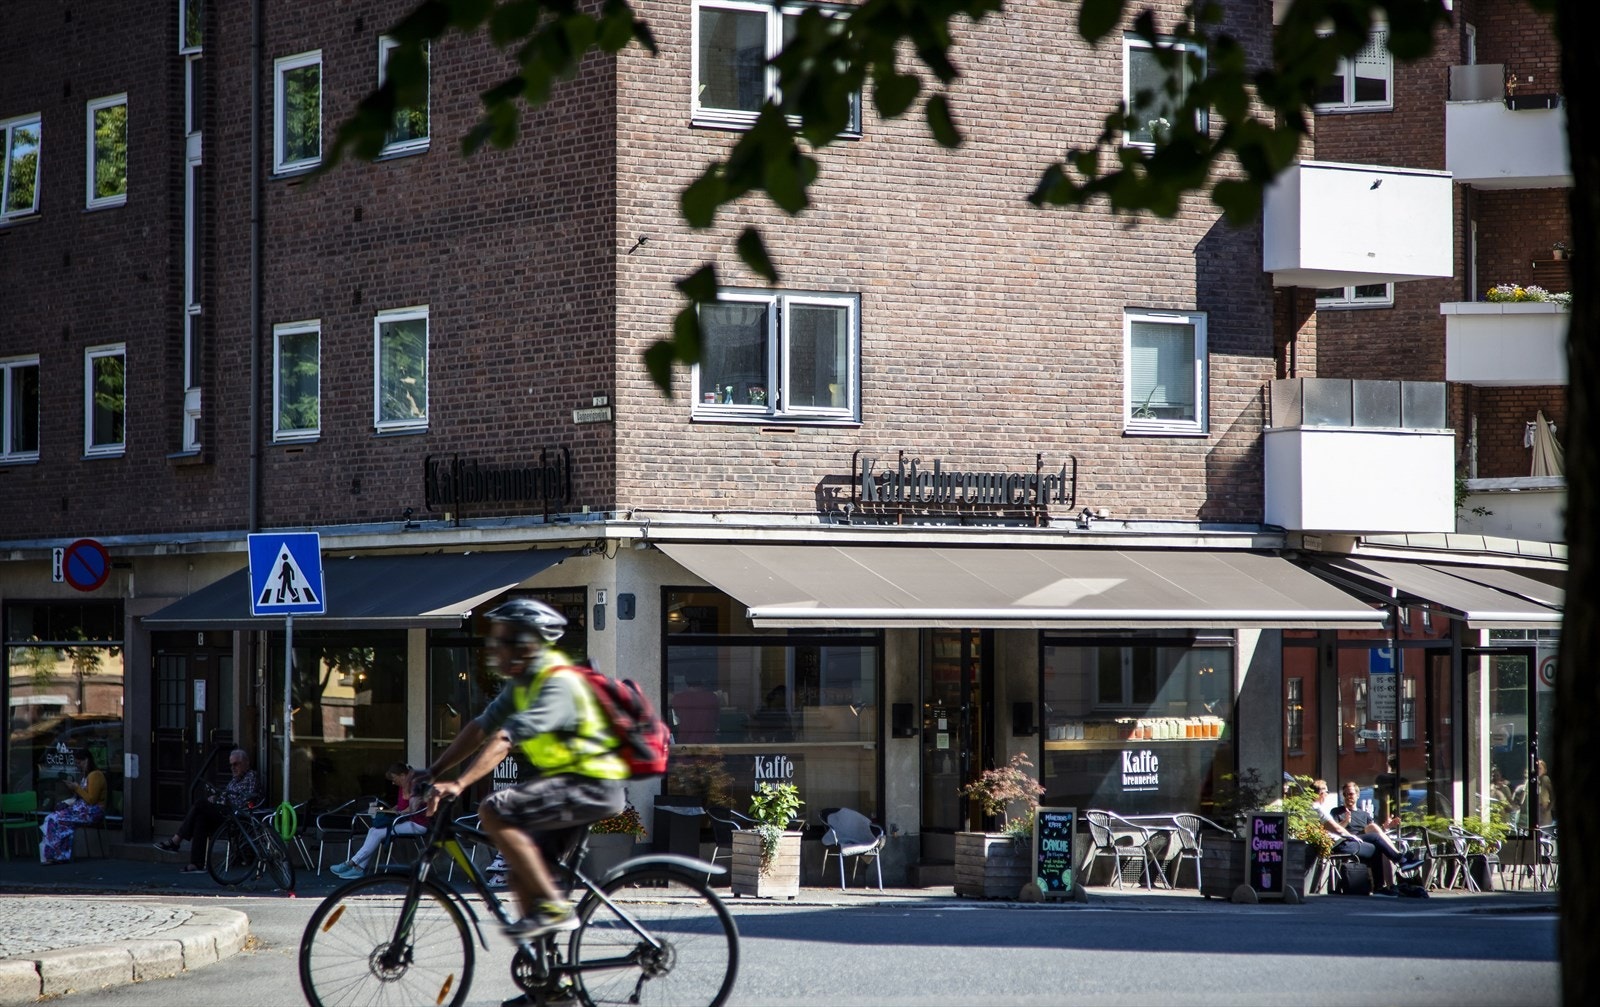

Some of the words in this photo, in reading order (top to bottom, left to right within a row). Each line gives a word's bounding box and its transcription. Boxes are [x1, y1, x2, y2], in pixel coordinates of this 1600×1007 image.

[428, 453, 567, 505] Kaffebrenneriet
[861, 457, 1070, 506] Kaffebrenneriet
[754, 755, 794, 779] Kaffe
[1122, 750, 1159, 773] Kaffe
[1122, 773, 1159, 785] brenneriet
